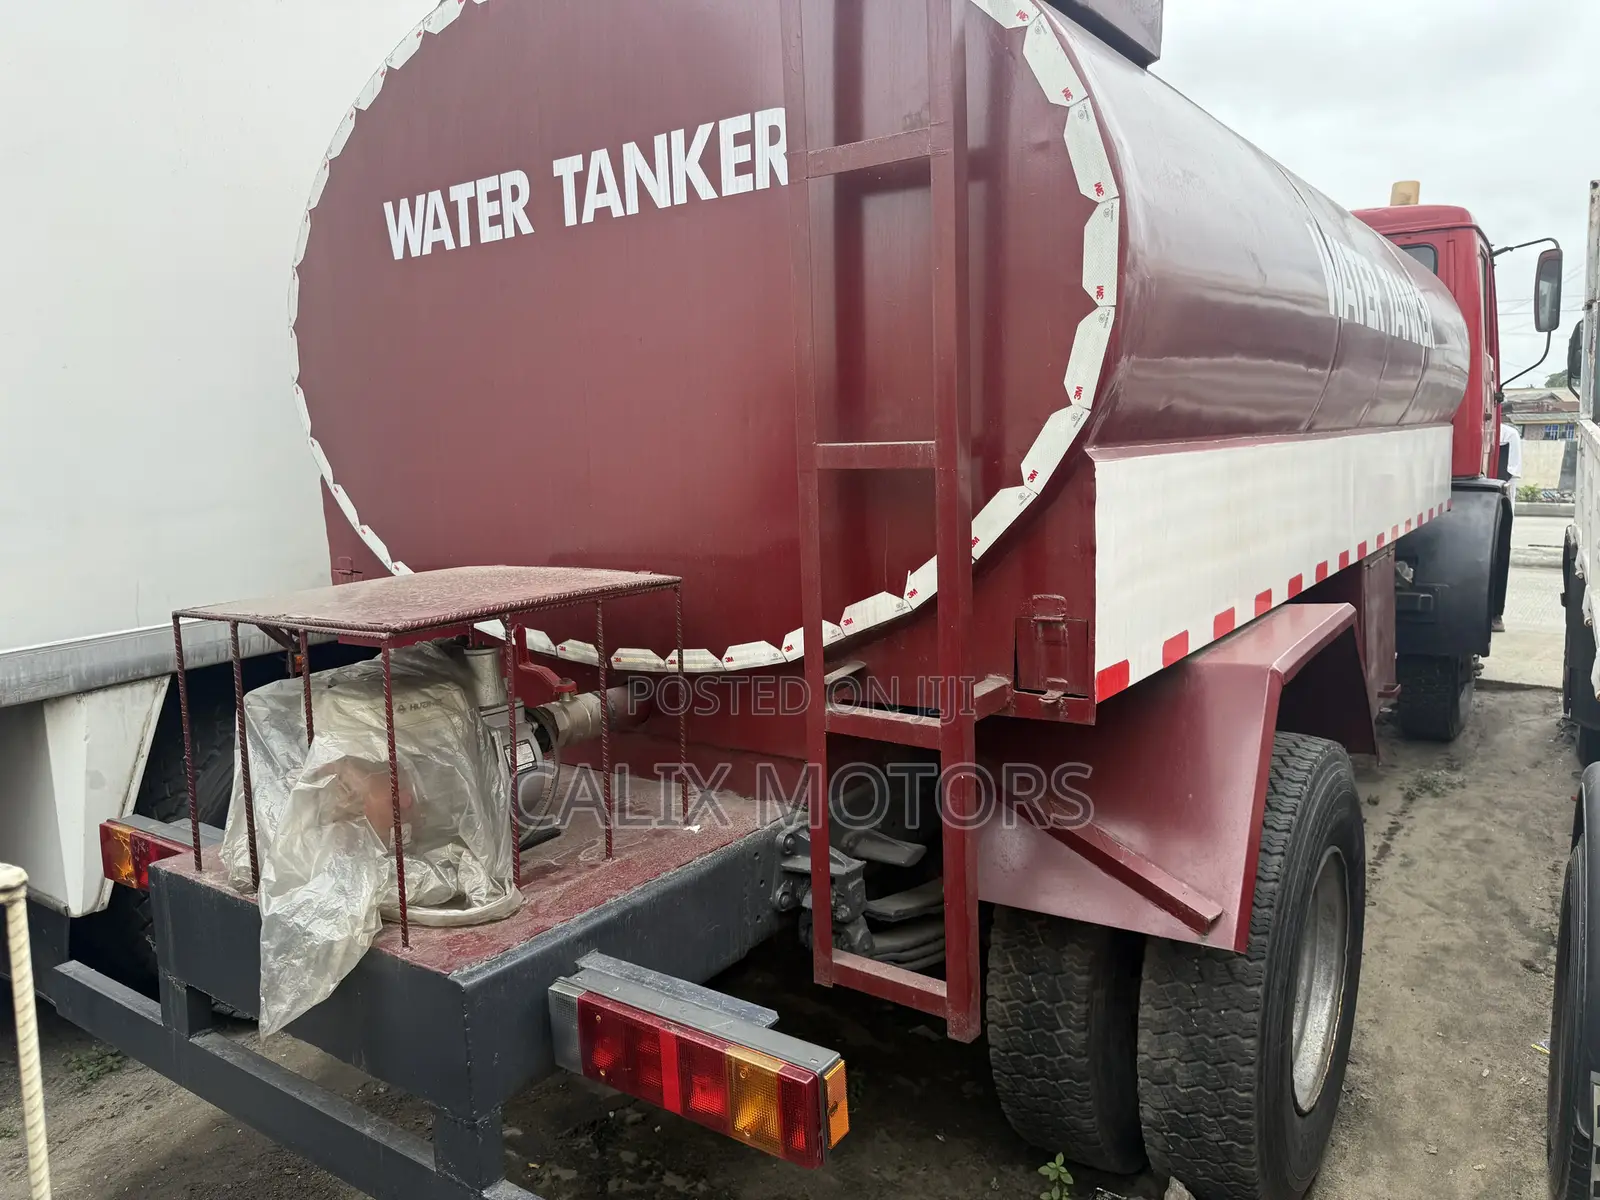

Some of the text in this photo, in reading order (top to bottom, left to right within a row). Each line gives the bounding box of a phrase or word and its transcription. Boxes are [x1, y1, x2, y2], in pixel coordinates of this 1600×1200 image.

[1062, 87, 1073, 101] 3M
[383, 107, 789, 260] WATER TANKER
[1094, 182, 1105, 197] 3M
[1305, 223, 1386, 333] WATER
[1096, 285, 1104, 300] 3M
[1074, 385, 1083, 400] 3M
[1027, 469, 1038, 483] 3M
[907, 588, 918, 599] 3M
[843, 617, 854, 626] 3M
[784, 644, 794, 653] 3M
